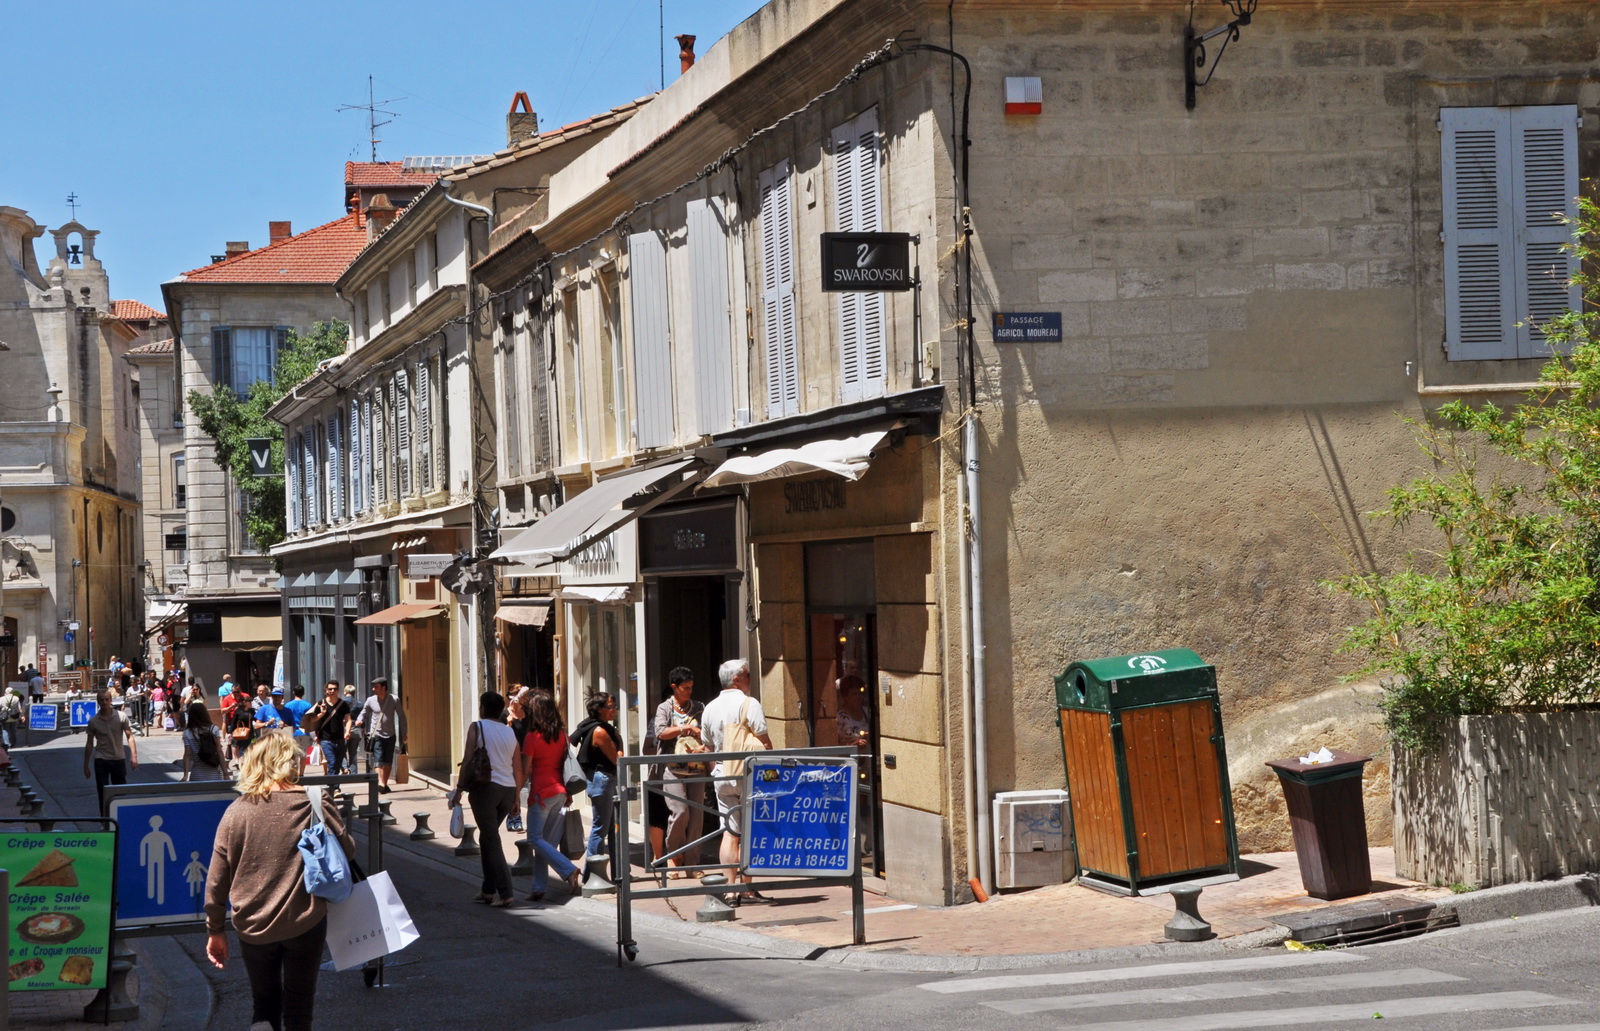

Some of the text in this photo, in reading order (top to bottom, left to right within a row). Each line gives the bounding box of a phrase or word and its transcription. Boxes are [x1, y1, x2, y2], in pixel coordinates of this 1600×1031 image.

[833, 268, 903, 281] SWAROVSKI
[997, 328, 1058, 337] AGRICOL MOUREAU
[251, 448, 270, 469] V
[793, 797, 831, 809] ZONE
[777, 811, 848, 824] PIETONNE
[7, 837, 97, 849] Crêpe Sucrée
[752, 837, 846, 850] LE MERCREDI
[751, 854, 765, 865] de
[794, 855, 802, 866] à
[8, 892, 90, 905] Crêpe Salée
[348, 926, 390, 946] sandro
[19, 946, 28, 956] et
[33, 945, 63, 957] Croque
[65, 945, 103, 955] monsieur
